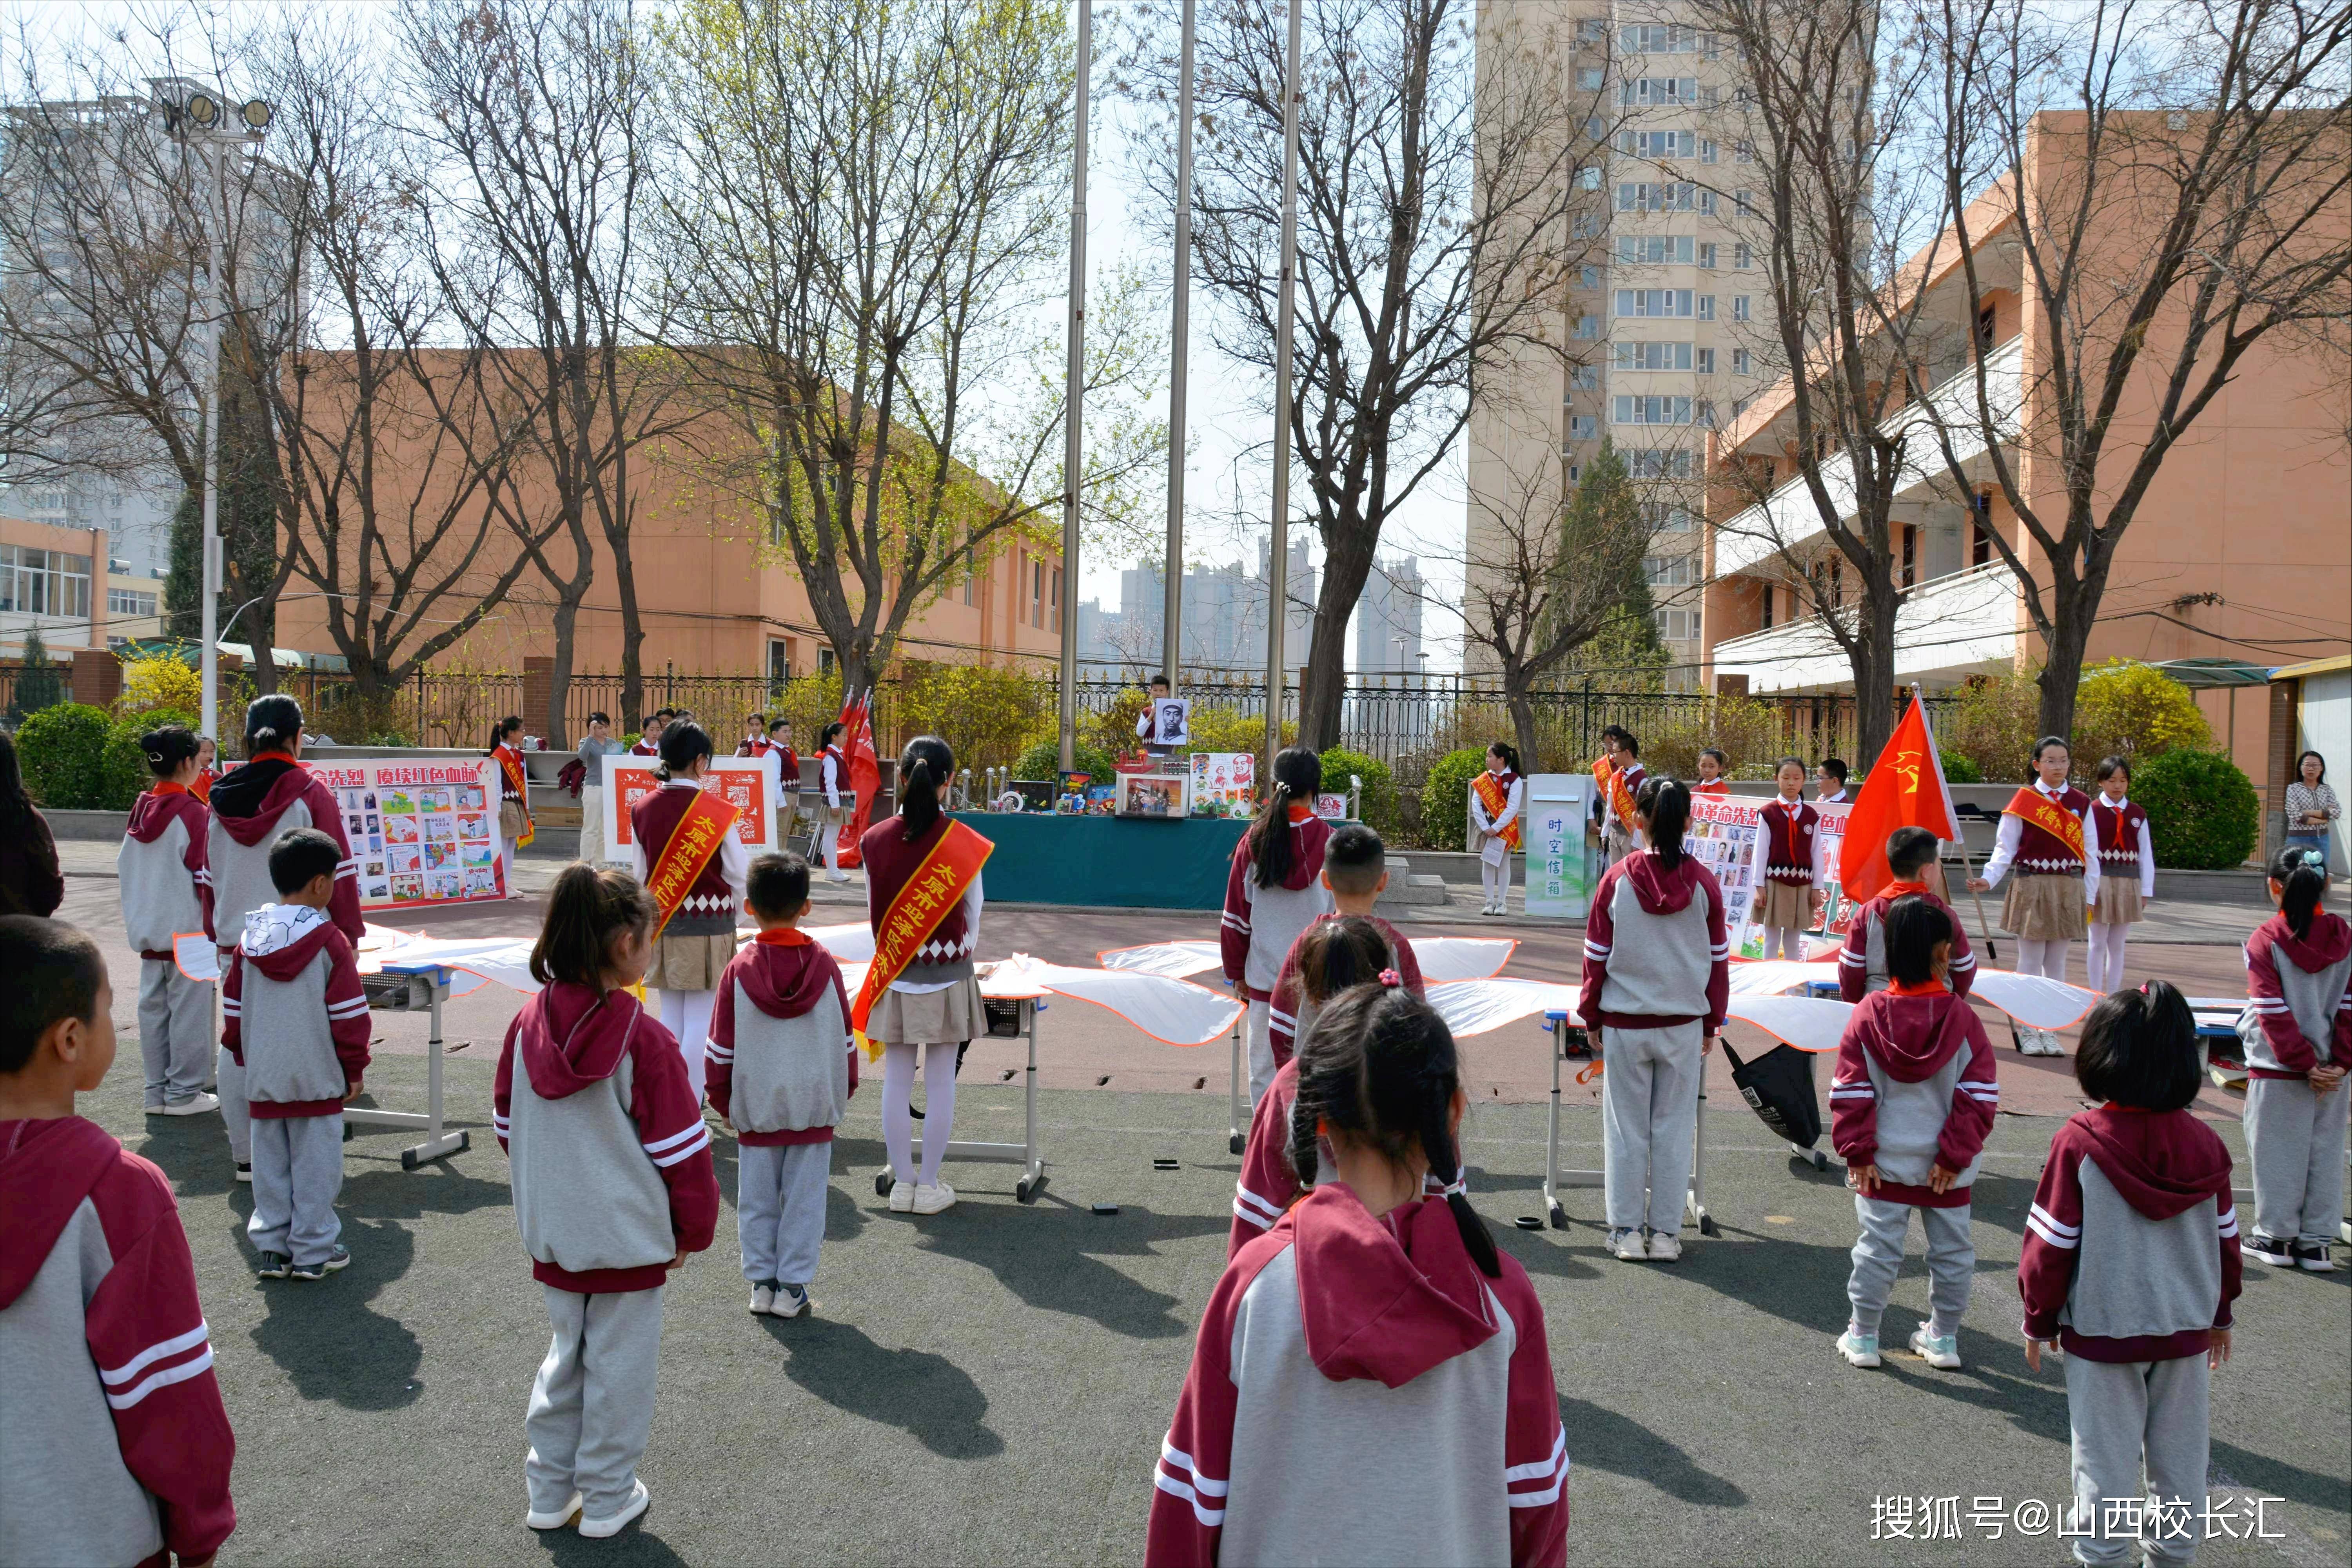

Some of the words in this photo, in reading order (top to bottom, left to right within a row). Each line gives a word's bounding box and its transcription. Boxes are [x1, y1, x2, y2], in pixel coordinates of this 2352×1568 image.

[377, 766, 478, 784] 赓续红色血脉
[1691, 802, 1759, 826] 怀革命先烈
[654, 815, 716, 907] 太原市迎泽区仁
[1547, 818, 1562, 895] 时空信箱
[869, 863, 956, 1000] 太原市迎泽区仁杰小
